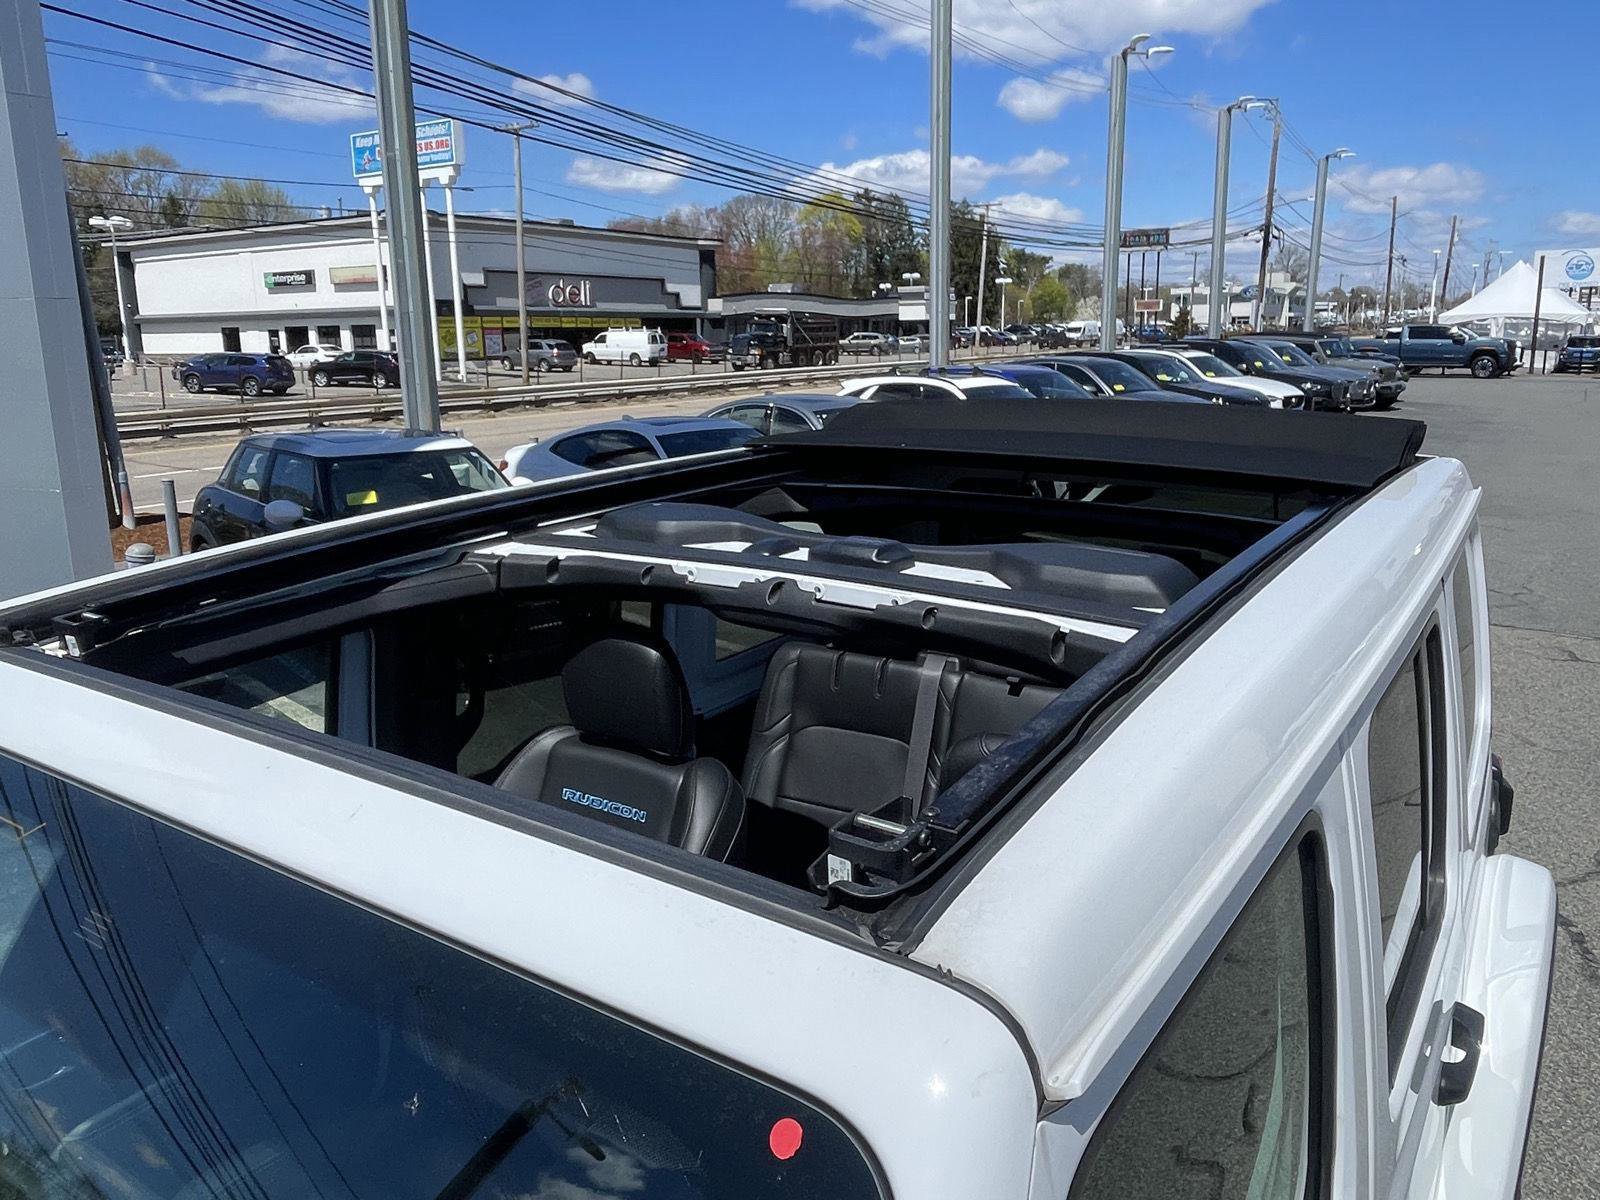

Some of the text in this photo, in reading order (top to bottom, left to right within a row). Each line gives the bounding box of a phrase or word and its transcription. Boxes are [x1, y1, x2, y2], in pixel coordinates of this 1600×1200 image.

[267, 272, 306, 285] enterprise
[548, 278, 592, 306] deli
[562, 788, 647, 822] RUBICON
